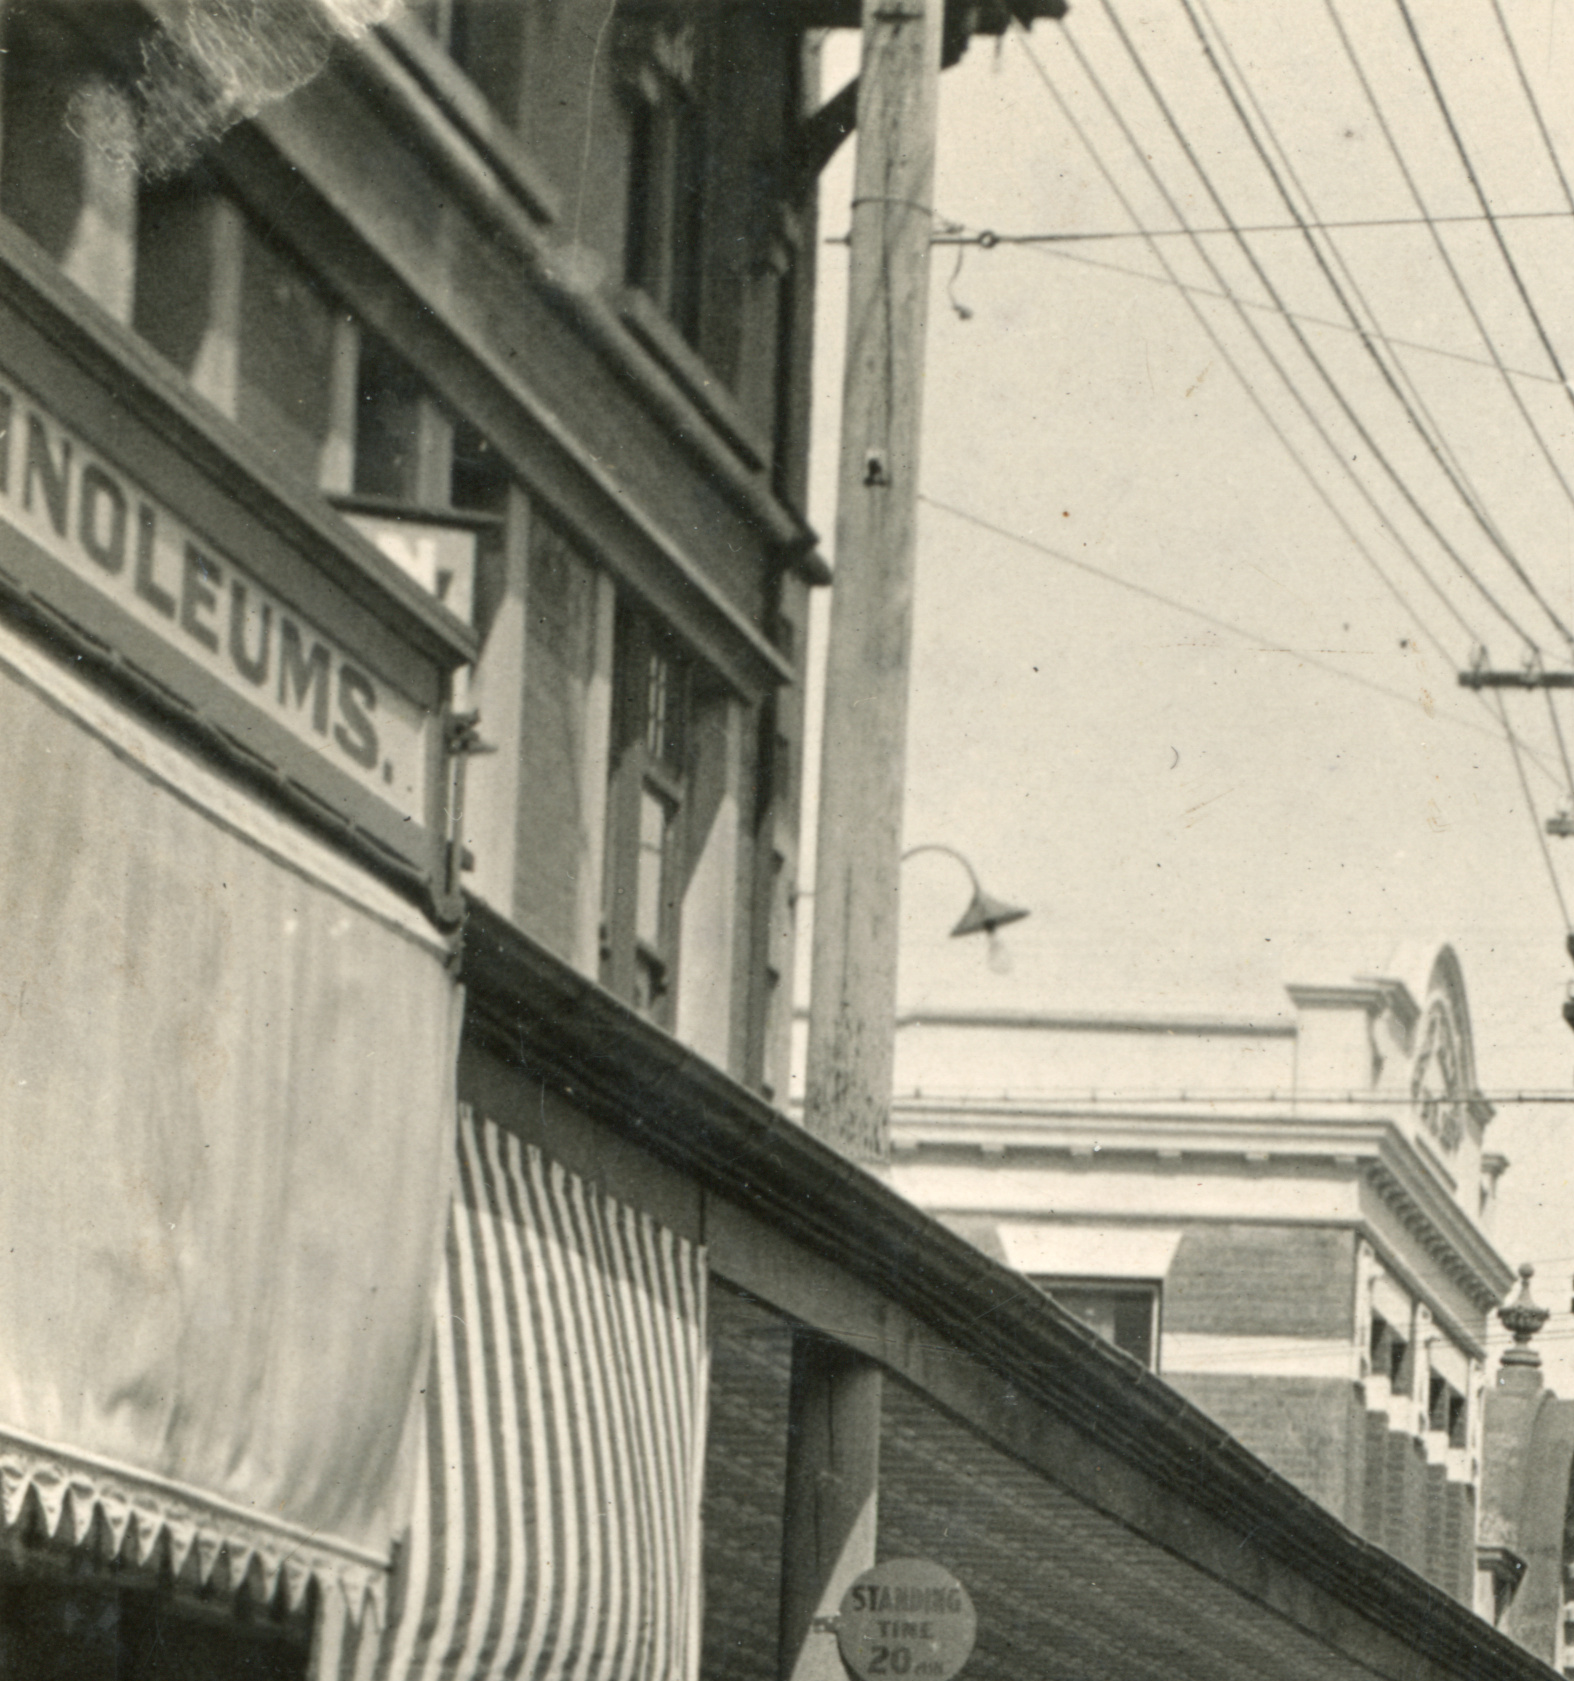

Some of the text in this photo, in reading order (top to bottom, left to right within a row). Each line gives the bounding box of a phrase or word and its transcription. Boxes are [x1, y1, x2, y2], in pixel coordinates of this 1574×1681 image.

[851, 1585, 963, 1614] STANDING
[876, 1620, 935, 1640] TIME
[867, 1645, 911, 1676] 20
